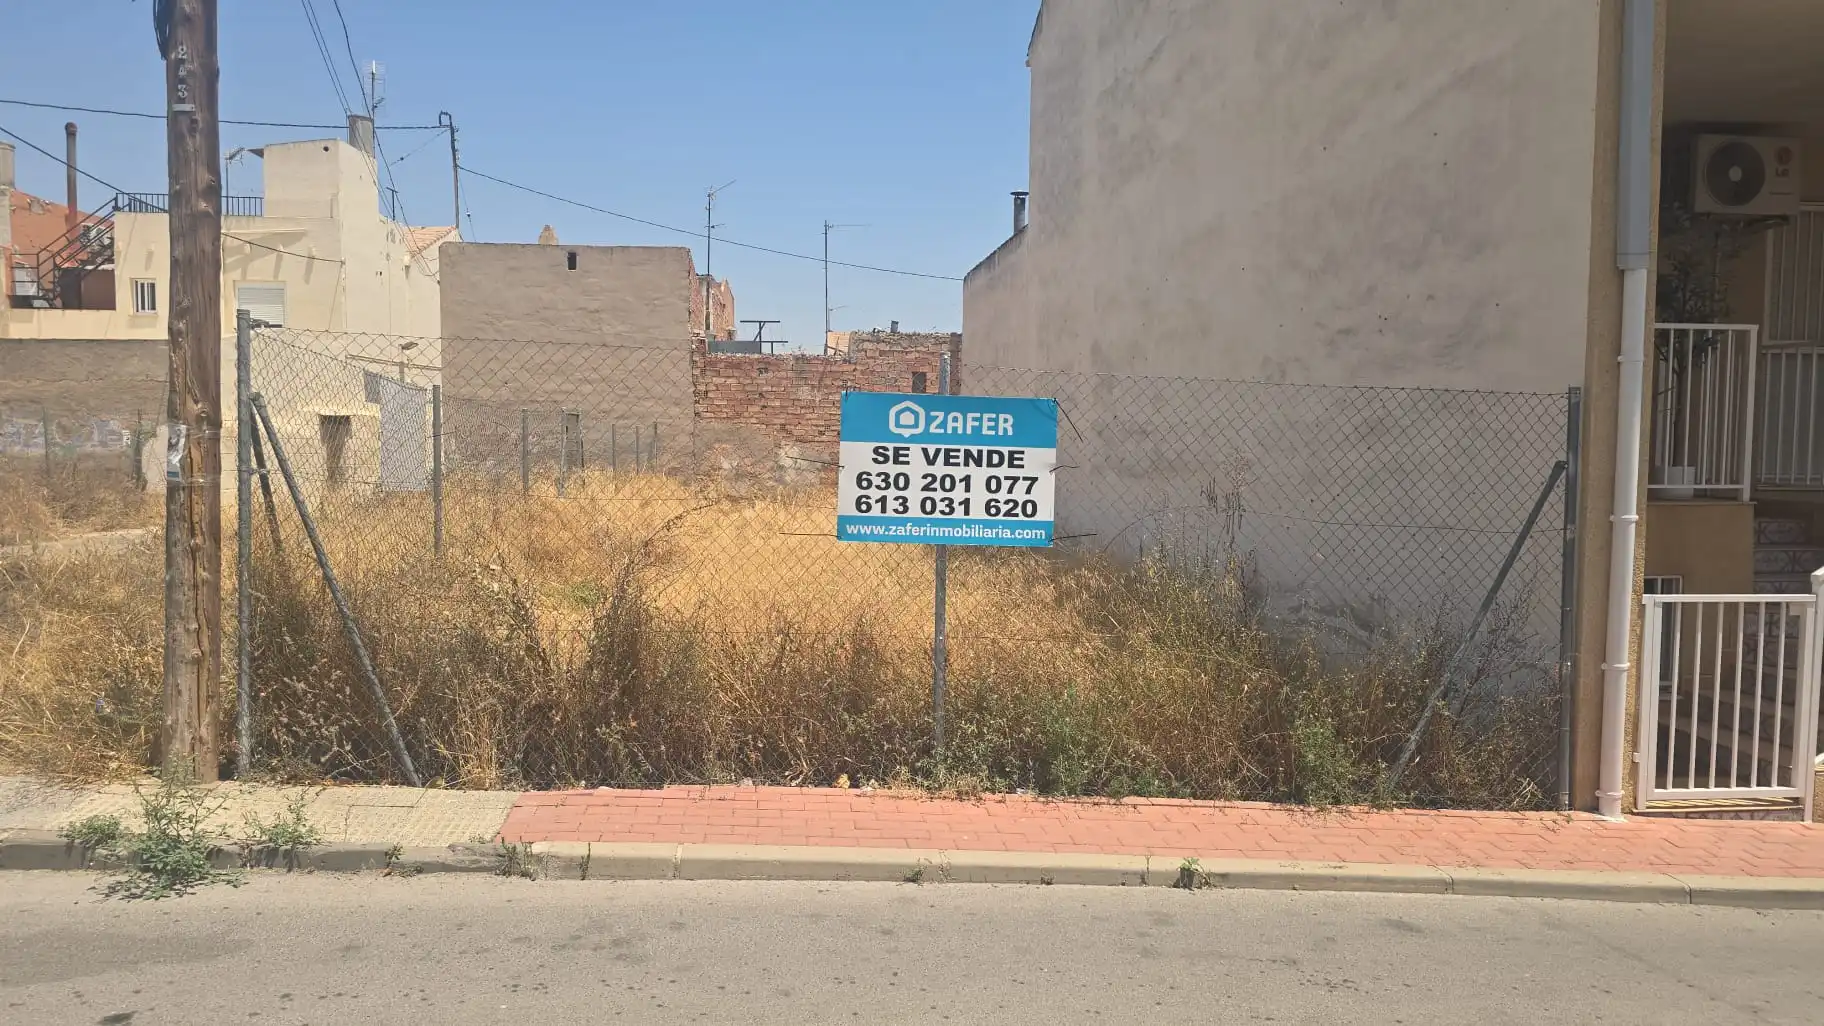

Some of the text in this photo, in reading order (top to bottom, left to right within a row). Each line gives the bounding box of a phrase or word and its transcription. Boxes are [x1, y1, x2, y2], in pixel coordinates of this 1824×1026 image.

[929, 411, 1014, 436] ZAFER
[871, 445, 1025, 469] SE VENDE
[855, 471, 1039, 495] 630 201 077
[854, 494, 1038, 518] 613 031 620
[846, 522, 1046, 540] www.zaferinmobiliaria.com
